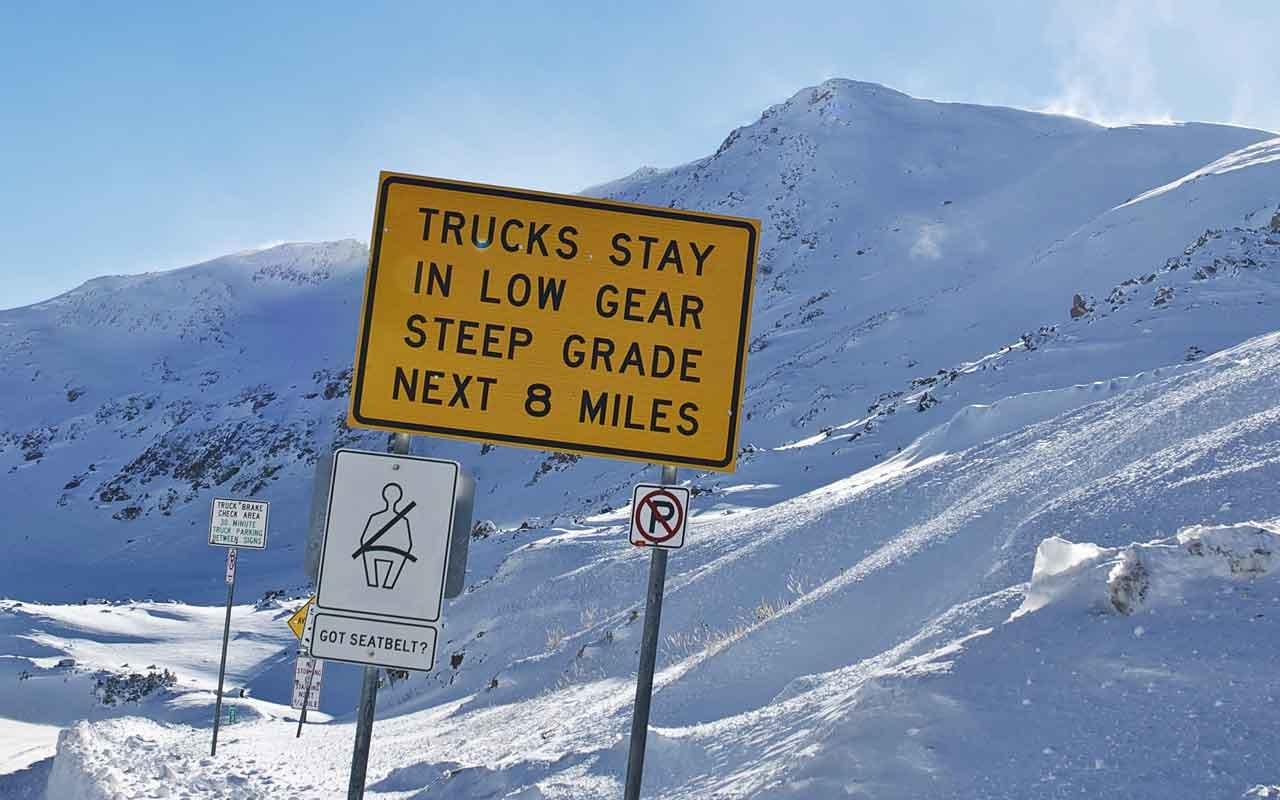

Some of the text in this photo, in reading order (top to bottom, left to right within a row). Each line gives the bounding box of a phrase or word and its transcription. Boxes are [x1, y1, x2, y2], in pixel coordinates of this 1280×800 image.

[419, 208, 715, 276] TRUCKS STAY
[414, 261, 704, 330] IN LOW GEAR
[404, 314, 702, 383] STEEP GRADE
[392, 367, 699, 436] NEXT 8 MILES
[217, 502, 264, 512] TRUCK BRAKE
[218, 510, 261, 520] CHECK AREA
[213, 526, 263, 537] TRUCK PARKING
[232, 520, 257, 528] MINUTE
[212, 535, 239, 543] BETWEEN
[320, 630, 429, 655] GOT SEATBELT?
